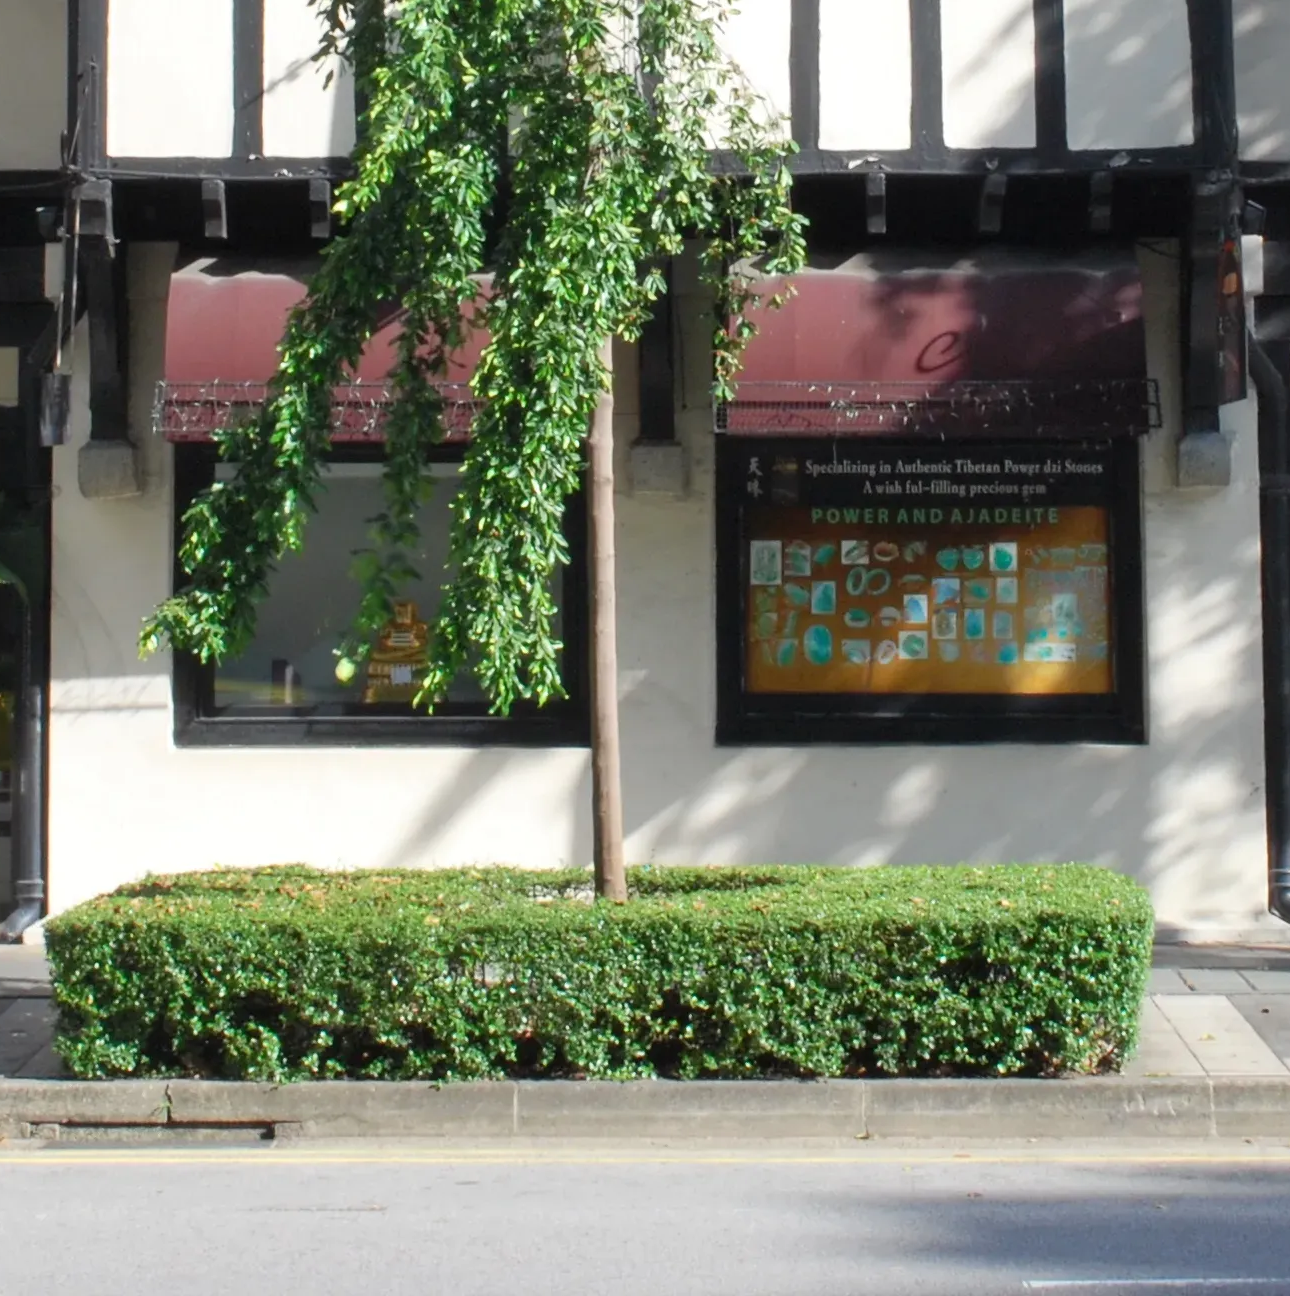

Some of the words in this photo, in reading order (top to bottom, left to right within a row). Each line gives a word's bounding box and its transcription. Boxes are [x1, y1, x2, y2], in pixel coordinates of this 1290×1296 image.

[805, 459, 876, 477] Specializing
[879, 460, 891, 473] in
[895, 459, 952, 473] Authentic
[954, 459, 1001, 473] Tibetan
[1004, 459, 1040, 474] Power
[1043, 459, 1061, 473] dzi
[1065, 459, 1103, 474] Stones
[863, 480, 872, 494] A
[875, 480, 902, 494] wish
[970, 480, 1019, 497] precious
[1021, 483, 1047, 497] gem
[811, 508, 889, 524] POWER
[896, 508, 943, 524] AND
